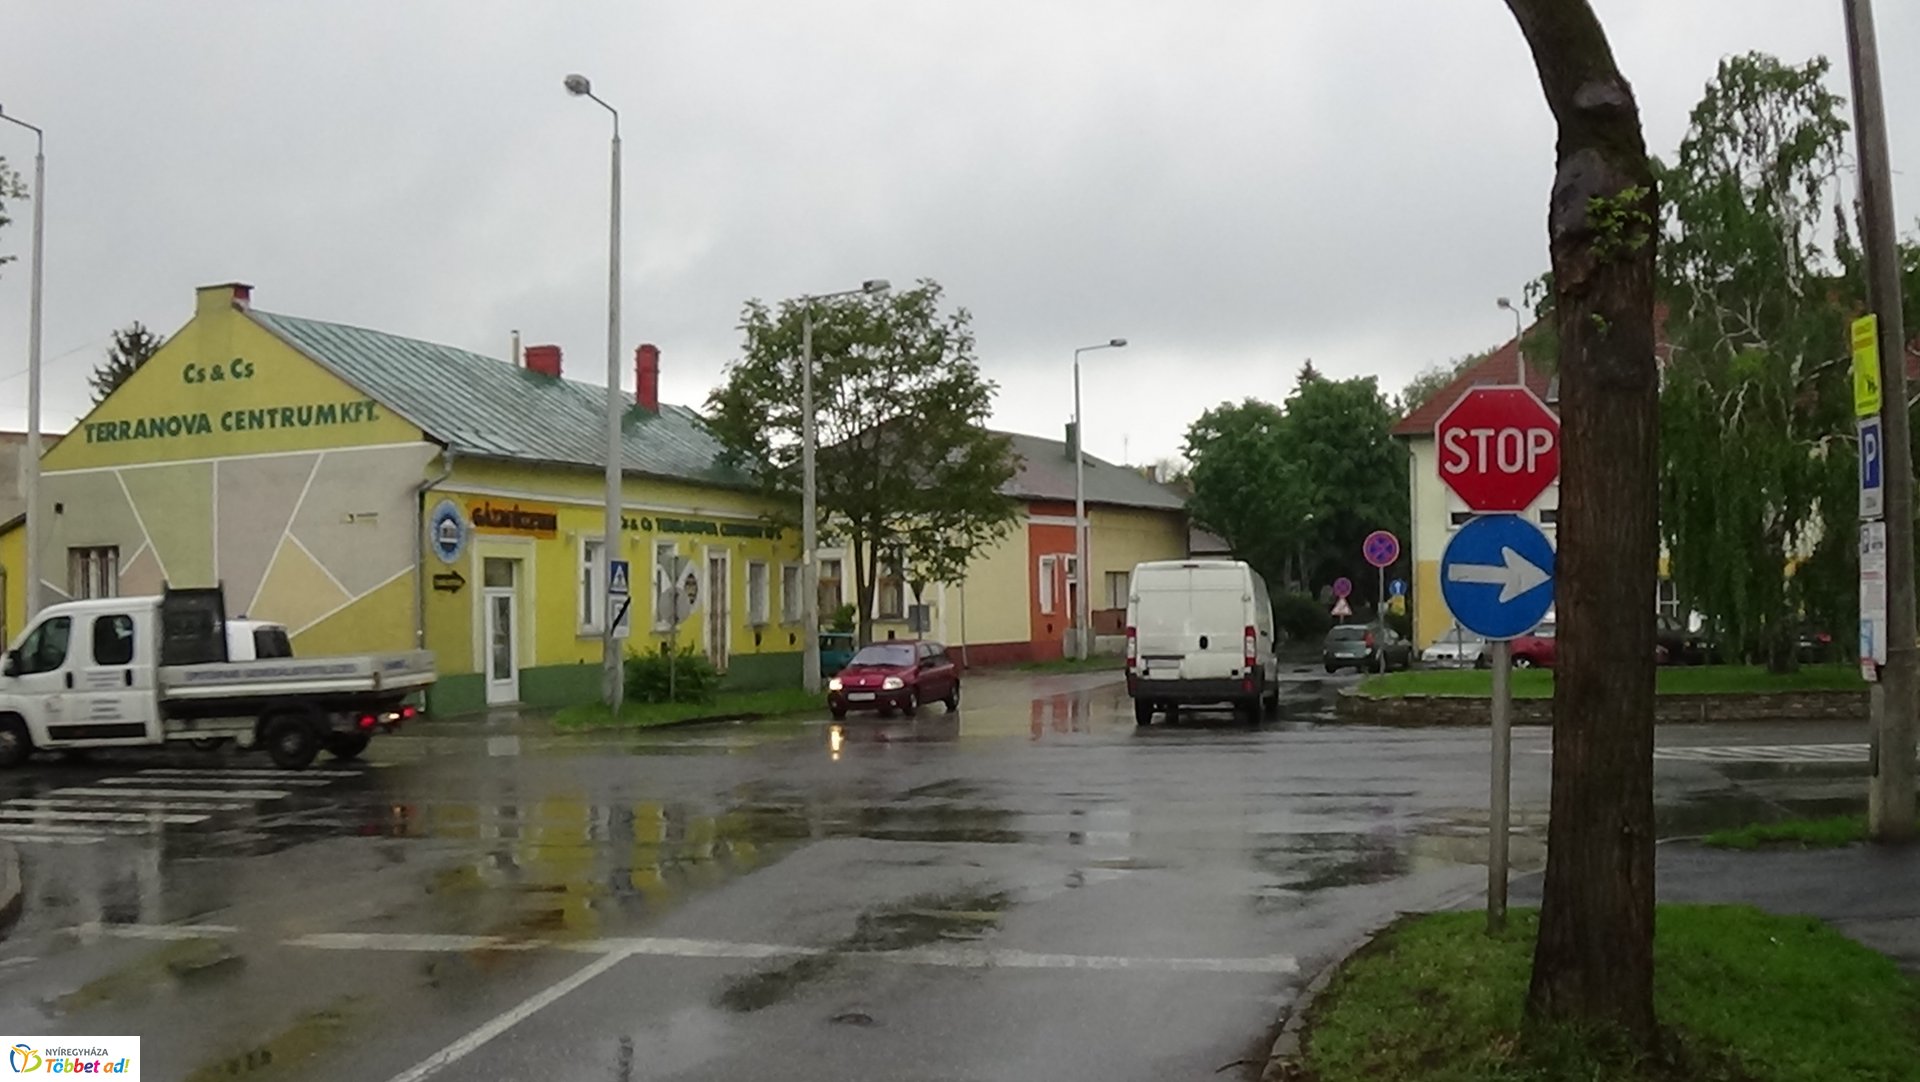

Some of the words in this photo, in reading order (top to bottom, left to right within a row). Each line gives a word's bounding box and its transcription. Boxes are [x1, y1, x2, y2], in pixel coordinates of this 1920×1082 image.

[183, 363, 206, 384] Cs
[210, 364, 225, 382] &
[230, 358, 254, 378] Cs
[84, 412, 212, 443] TERRANOVA
[1444, 427, 1554, 474] STOP
[1865, 433, 1876, 481] P
